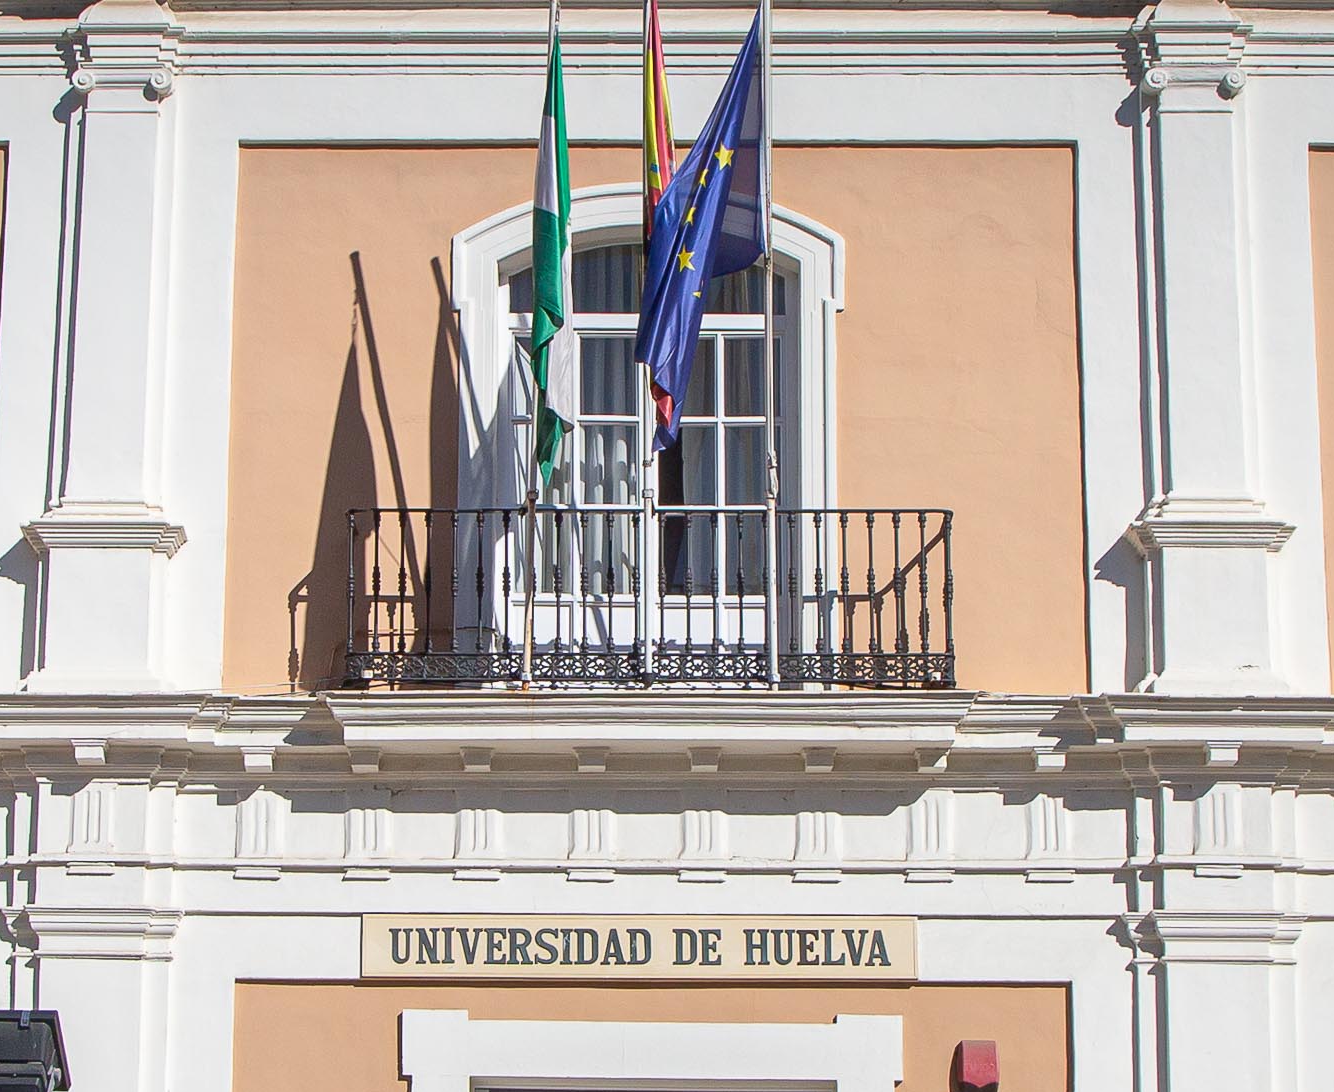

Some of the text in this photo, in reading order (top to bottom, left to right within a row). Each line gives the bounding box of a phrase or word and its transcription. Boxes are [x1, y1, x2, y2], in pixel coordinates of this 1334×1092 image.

[388, 926, 891, 966] UNIVERSIDAD DE HUELVA
